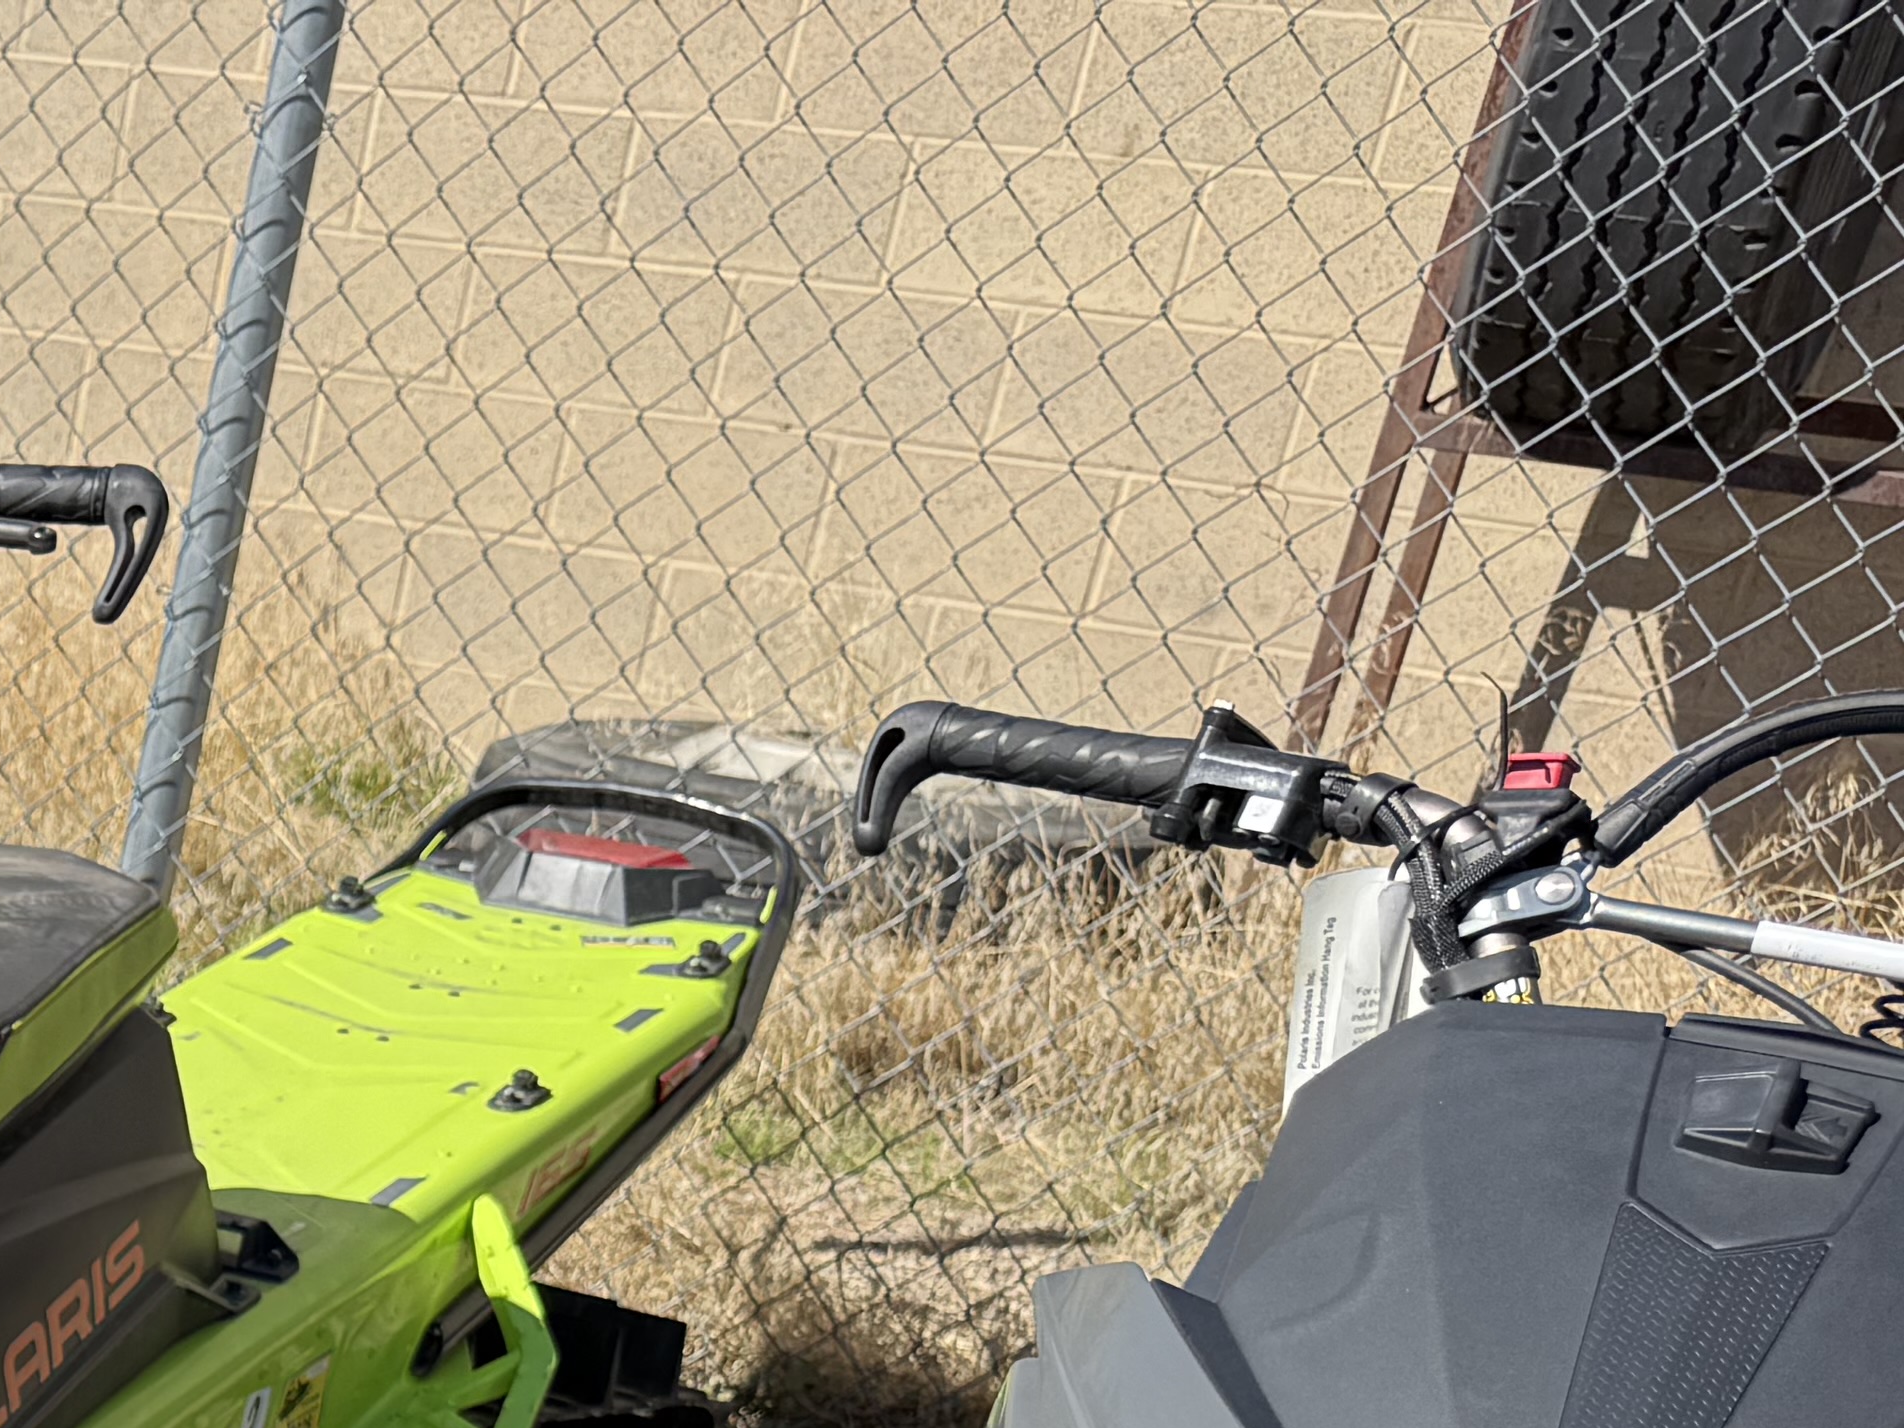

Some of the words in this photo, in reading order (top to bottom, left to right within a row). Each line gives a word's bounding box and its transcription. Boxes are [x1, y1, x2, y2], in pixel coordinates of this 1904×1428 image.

[1324, 917, 1337, 935] Tag
[1322, 936, 1335, 962] Hang
[1305, 969, 1316, 986] Inc.
[1317, 963, 1329, 1019] Information
[1301, 987, 1314, 1035] Industries
[1297, 1036, 1309, 1069] Polaris
[1312, 1016, 1325, 1069] Emissions
